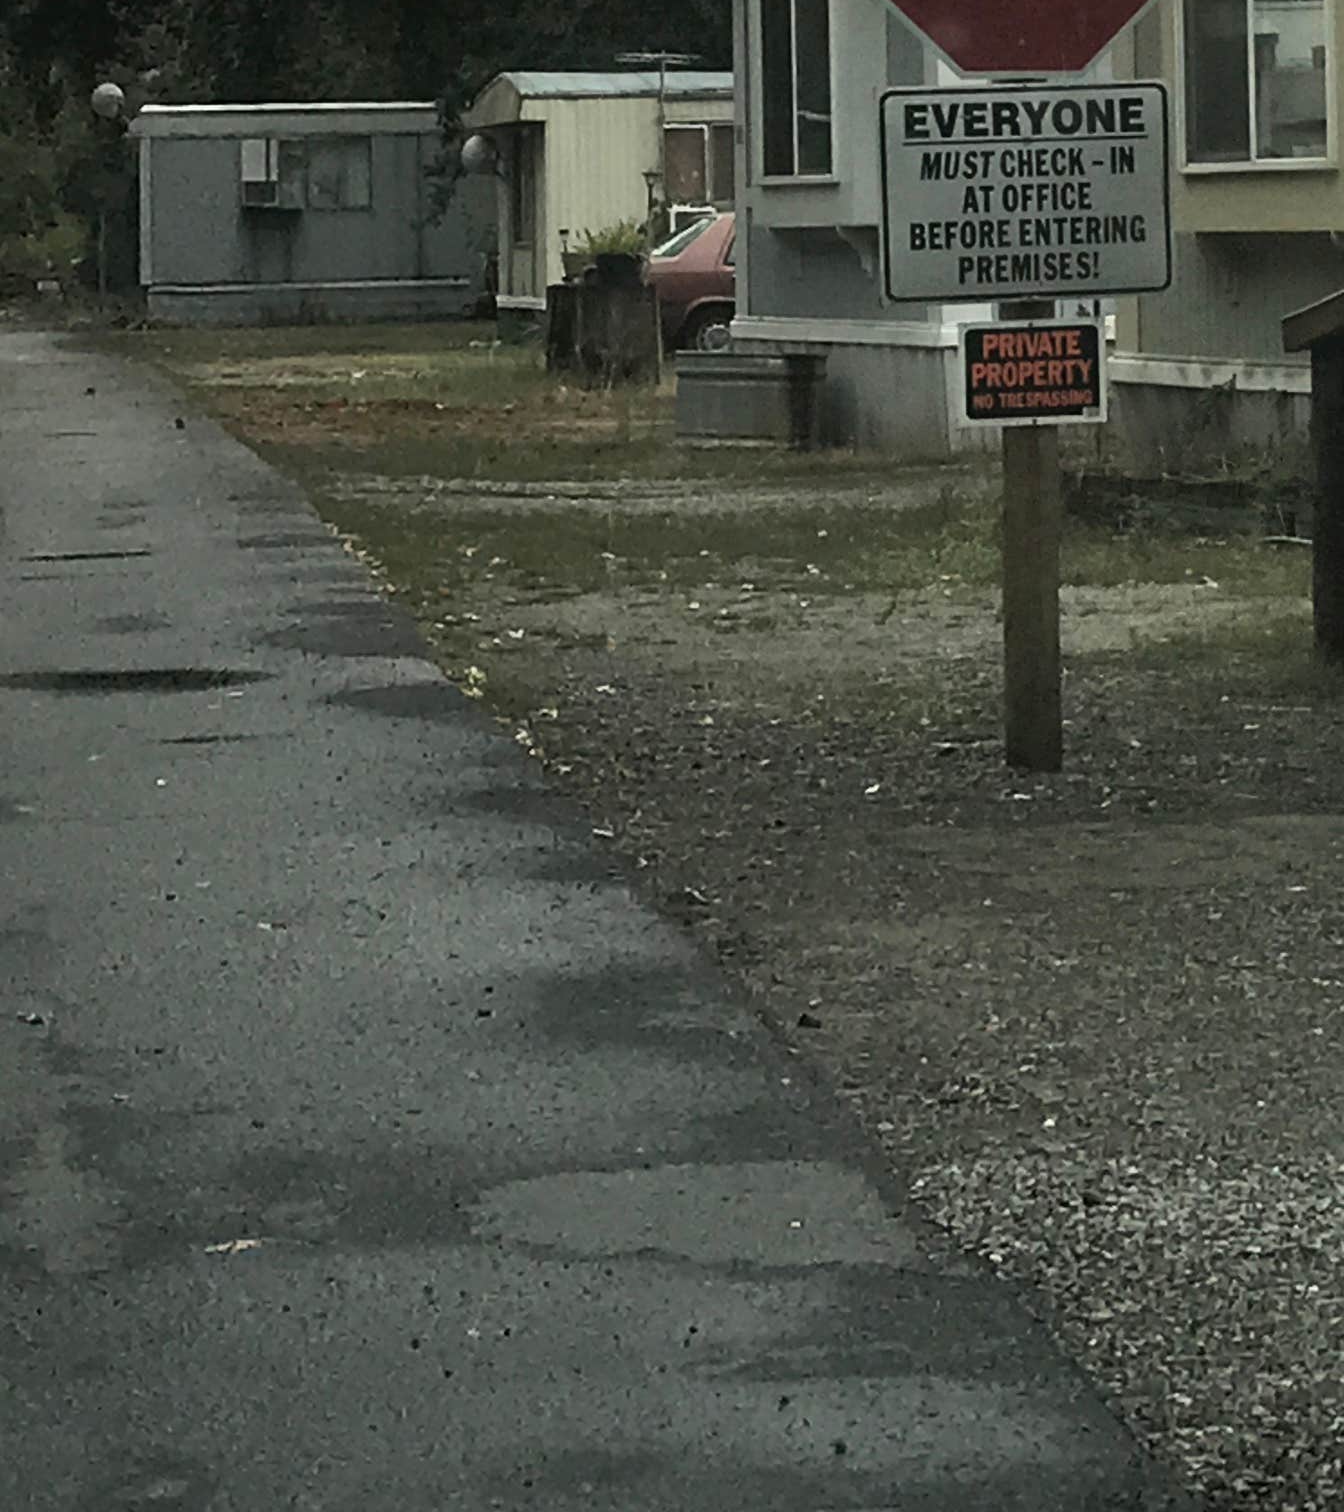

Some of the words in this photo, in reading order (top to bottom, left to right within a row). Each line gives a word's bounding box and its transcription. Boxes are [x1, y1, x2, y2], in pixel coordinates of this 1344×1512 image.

[903, 97, 1146, 139] EVERYONE
[920, 150, 995, 180] MUST
[962, 186, 995, 214] AT
[1002, 182, 1093, 212] OFFICE
[909, 220, 1013, 251] BEFORE
[1019, 215, 1147, 246] ENTERING
[958, 252, 1099, 285] PREMISES!
[982, 330, 1082, 360] PRIVATE
[971, 359, 1093, 387] PROPERTY
[973, 394, 994, 410] NO
[998, 390, 1094, 409] TRESPASSING
